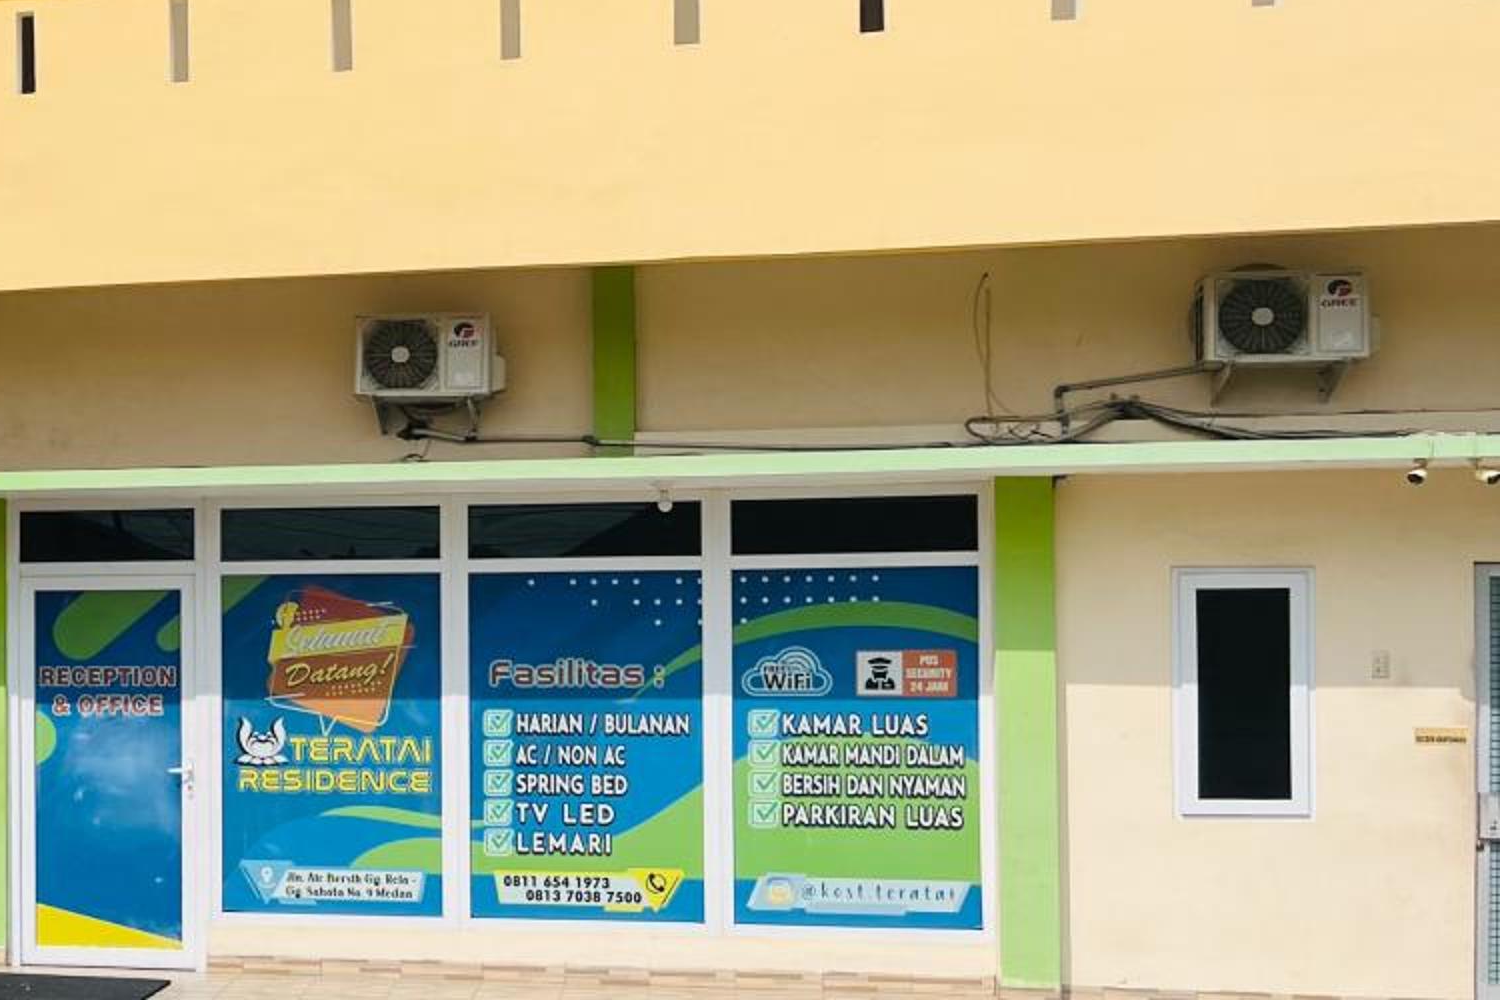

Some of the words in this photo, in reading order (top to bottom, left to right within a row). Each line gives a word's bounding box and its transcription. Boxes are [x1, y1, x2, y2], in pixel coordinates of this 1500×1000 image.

[40, 666, 177, 687] RECEPTION
[285, 653, 395, 688] Datang!
[490, 659, 645, 687] Fasilitas
[764, 673, 811, 690] WiFi
[52, 694, 71, 716] &
[77, 694, 165, 717] OFFICE
[516, 713, 584, 735] HARIAN
[589, 713, 599, 735] /
[604, 713, 690, 736] BULANAN
[783, 714, 861, 736] KAMAR
[872, 714, 929, 736] LUAS
[289, 736, 432, 764] TERATAI
[516, 745, 538, 766] AC
[543, 744, 552, 766] /
[558, 745, 598, 766] NON
[603, 746, 626, 767] AC
[783, 744, 839, 766] KAMAR
[845, 744, 901, 767] MANDI
[906, 745, 965, 767] DALAM
[238, 768, 433, 793] RESIDENCE
[516, 774, 584, 795] SPRING
[591, 775, 628, 796] BED
[783, 775, 840, 796] BERSIH
[847, 775, 883, 797] DAN
[890, 775, 966, 797] NYAMAN
[516, 803, 549, 824] TV
[563, 803, 615, 825] LED
[783, 804, 897, 827] PARKIRAN
[906, 805, 964, 828] LUAS
[516, 833, 613, 855] LEMARI
[503, 875, 538, 887] 0811
[543, 876, 570, 889] 654
[576, 877, 610, 889] 1973
[526, 889, 561, 901] 0813
[566, 890, 601, 902] 7038
[607, 891, 643, 903] 7500
